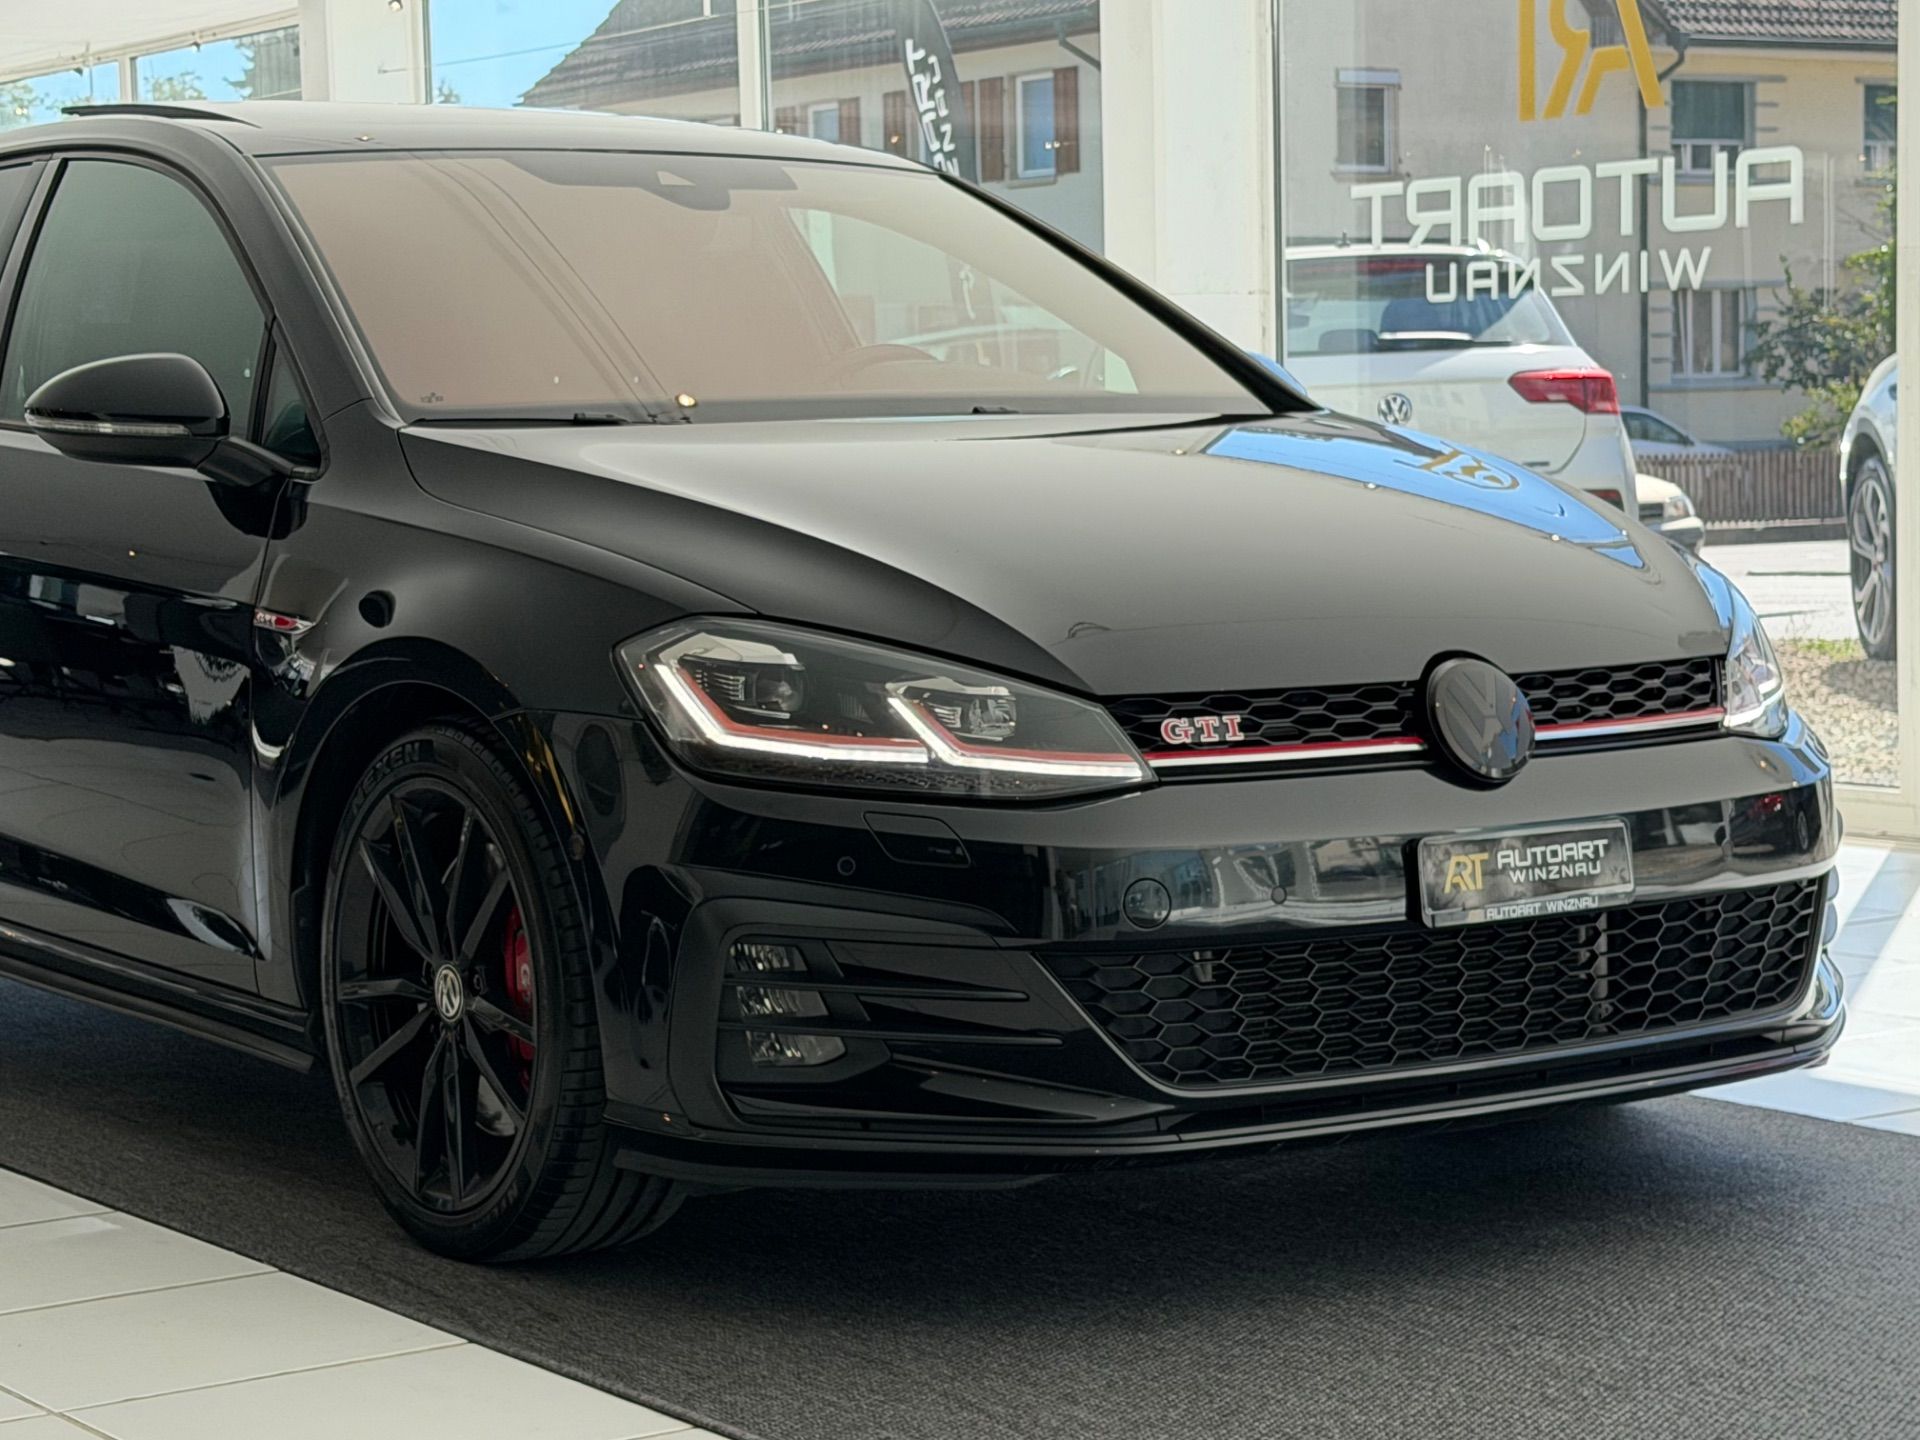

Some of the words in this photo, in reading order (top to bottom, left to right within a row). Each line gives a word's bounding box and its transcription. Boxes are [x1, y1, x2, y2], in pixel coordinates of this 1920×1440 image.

[1161, 714, 1245, 745] GTI
[1497, 839, 1608, 870] AUTOART
[1509, 860, 1601, 883] WINZNAU
[1486, 904, 1541, 920] AUTOART
[1547, 897, 1599, 912] WINZNAU
